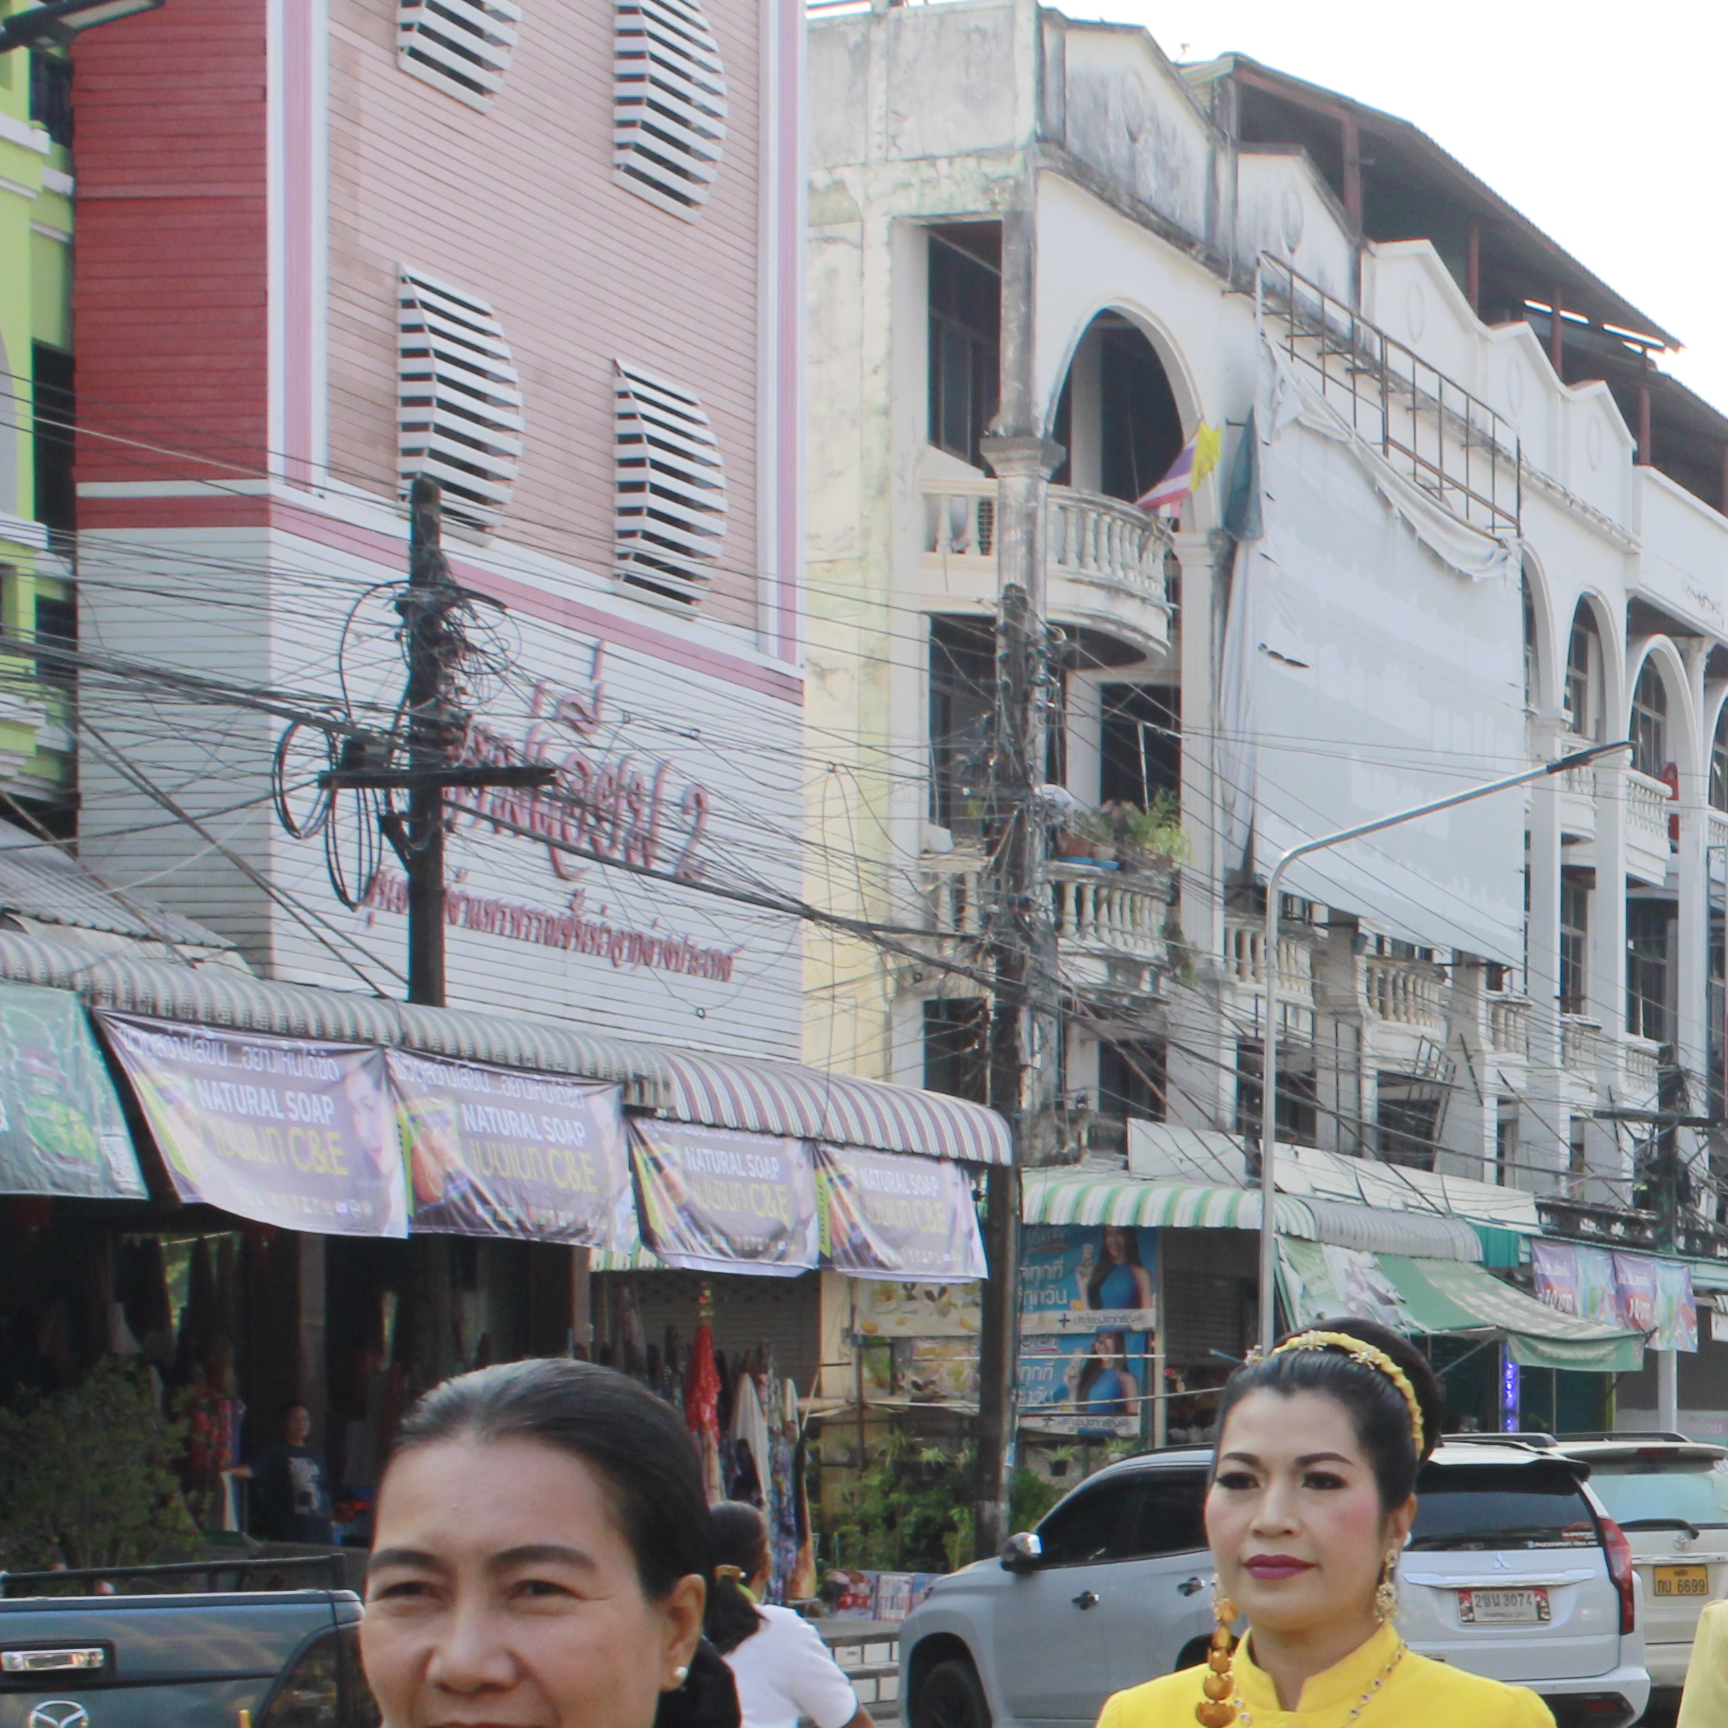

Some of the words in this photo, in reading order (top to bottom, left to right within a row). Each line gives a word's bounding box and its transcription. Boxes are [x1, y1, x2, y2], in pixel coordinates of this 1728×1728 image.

[674, 783, 710, 881] 2
[196, 1078, 285, 1120] NATURAL
[286, 1092, 335, 1125] SOAP
[461, 1103, 543, 1141] NATURAL
[543, 1115, 587, 1147] SOAP
[290, 1127, 349, 1176] C&E
[549, 1147, 599, 1193] C&E
[687, 1148, 746, 1177] NATURAL
[747, 1156, 781, 1181] SOAP
[750, 1183, 790, 1219] C&E
[860, 1167, 908, 1194] NATURAL
[908, 1172, 940, 1198] SOAP
[1503, 1592, 1533, 1608] 3074
[1677, 1578, 1706, 1593] 6699
